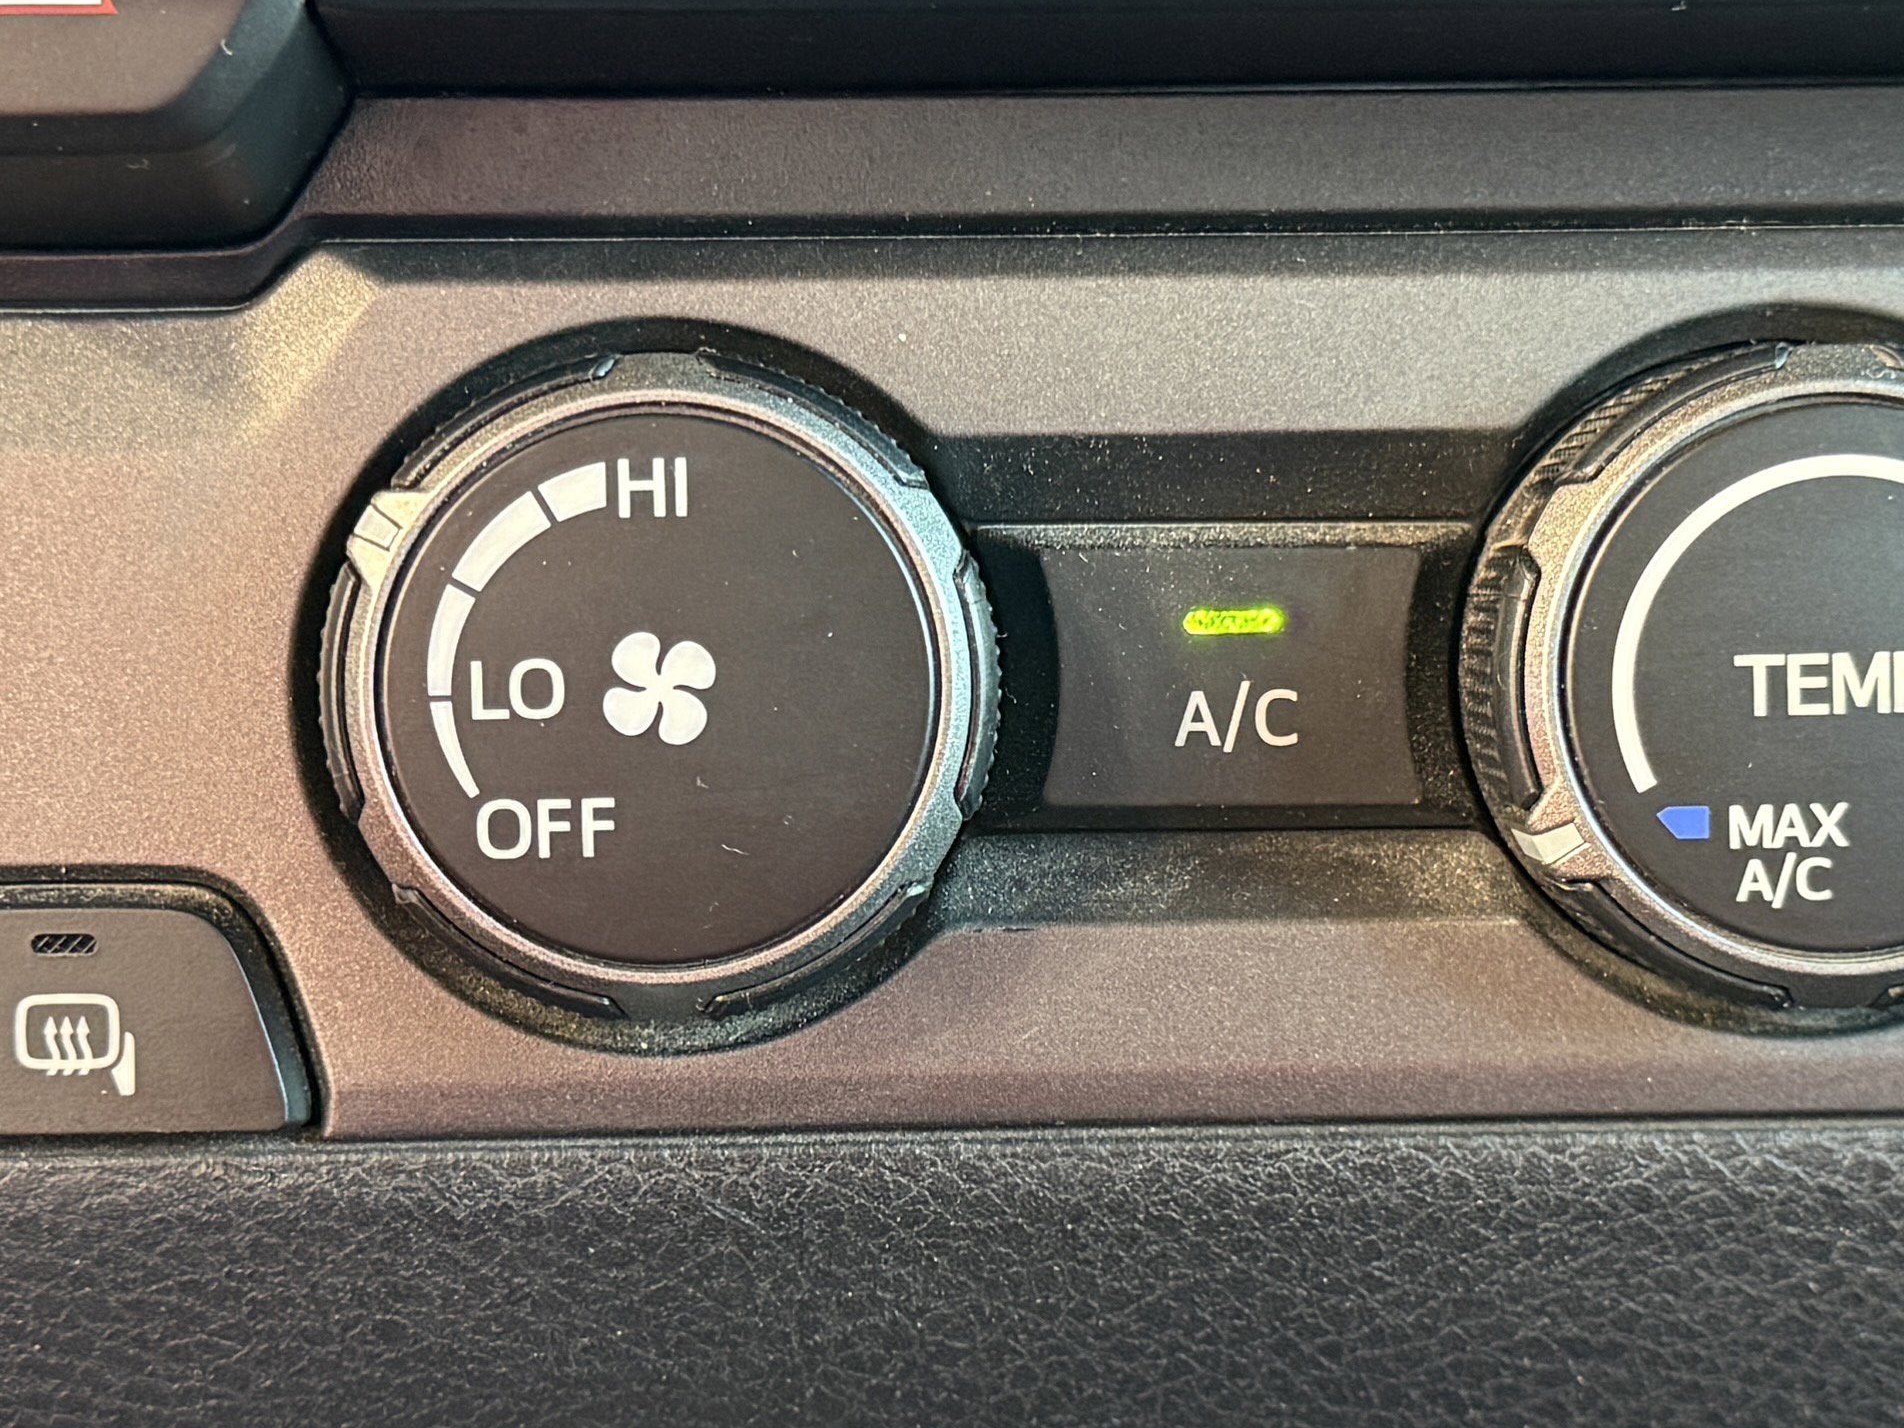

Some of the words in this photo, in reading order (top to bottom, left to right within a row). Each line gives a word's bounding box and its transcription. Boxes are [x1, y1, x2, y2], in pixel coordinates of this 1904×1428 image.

[617, 456, 688, 518] HI
[470, 658, 566, 721] LO
[1174, 680, 1300, 752] A/C
[475, 796, 616, 860] OFF
[1728, 802, 1851, 850] MAX
[1735, 853, 1835, 909] A/C
